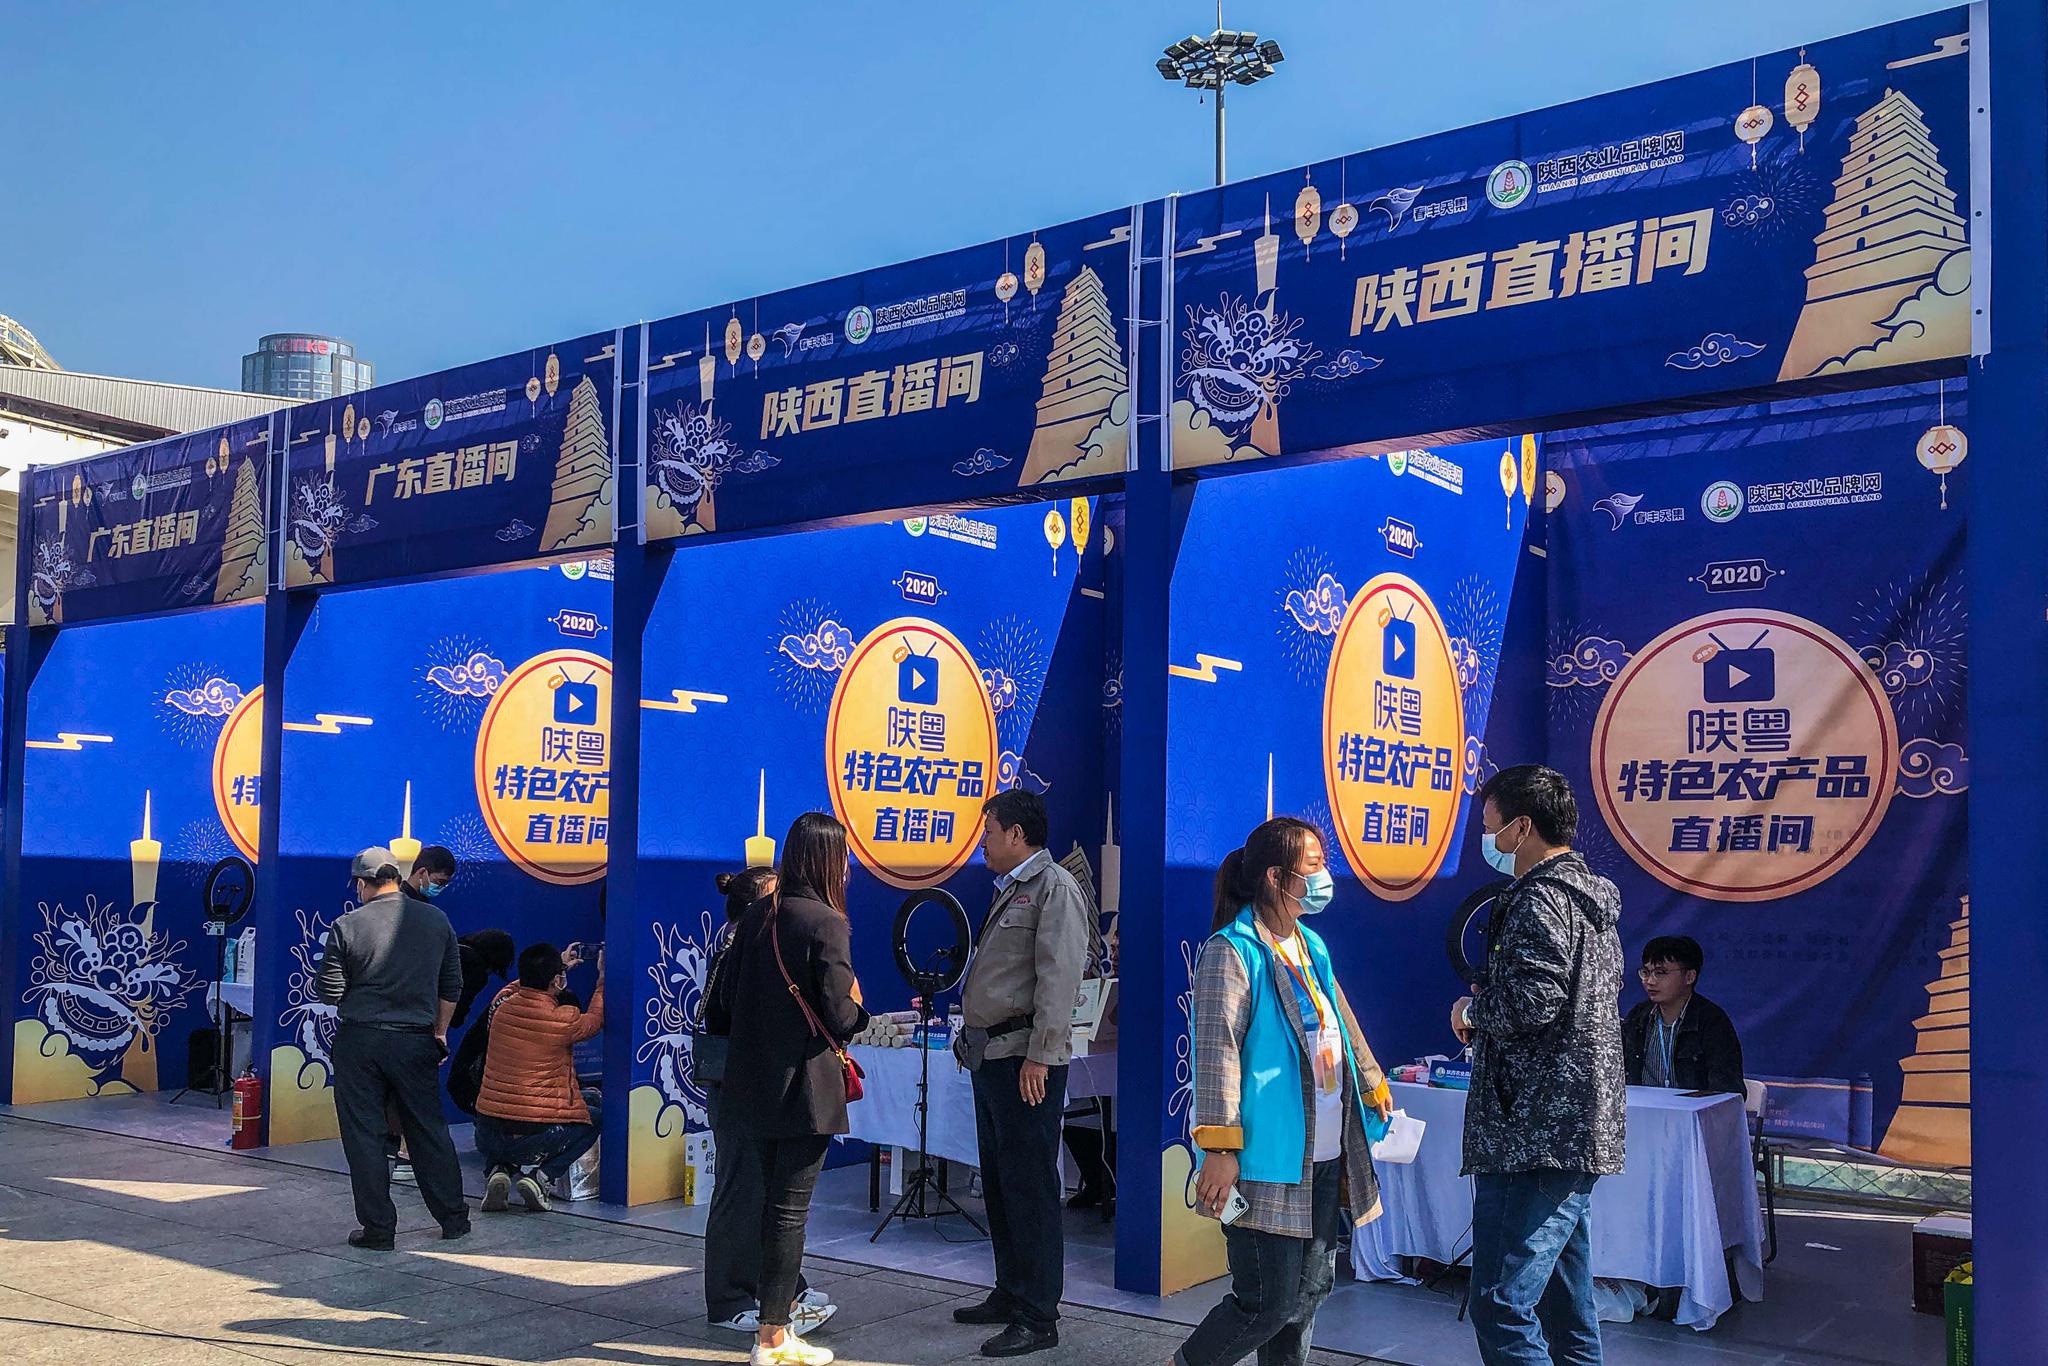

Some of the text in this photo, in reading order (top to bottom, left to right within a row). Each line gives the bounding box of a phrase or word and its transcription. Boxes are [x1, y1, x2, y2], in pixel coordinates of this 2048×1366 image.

[1537, 131, 1684, 182] 陕西农业品牌网
[1537, 154, 1684, 193] SHAANXI AGRICULTURAL BRAND
[1350, 208, 1714, 337] 陕西直播间
[876, 289, 966, 326] 陕西农业品牌网
[760, 351, 984, 440] 陕西直播间
[365, 440, 518, 506] 广东直播间
[1747, 472, 1882, 504] 陕西农业品牌网
[1748, 493, 1882, 514] SHAANXI AGRICULTURAL BRAND
[87, 510, 199, 563] 广东直播间
[1388, 525, 1413, 549] 2020
[905, 577, 935, 597] 2020
[1711, 565, 1761, 585] 2020
[562, 614, 594, 632] 2020
[886, 706, 946, 753] 陕粤
[1374, 680, 1422, 737] 陕粤
[1688, 707, 1791, 754] 陕粤
[541, 726, 605, 767] 陕粤
[1337, 732, 1453, 792] 特色农产品
[843, 749, 984, 798] 特色农产品
[1617, 755, 1871, 802] 特色农产品
[872, 807, 955, 844] 直播间
[1361, 801, 1430, 847] 直播间
[1667, 814, 1815, 853] 直播间
